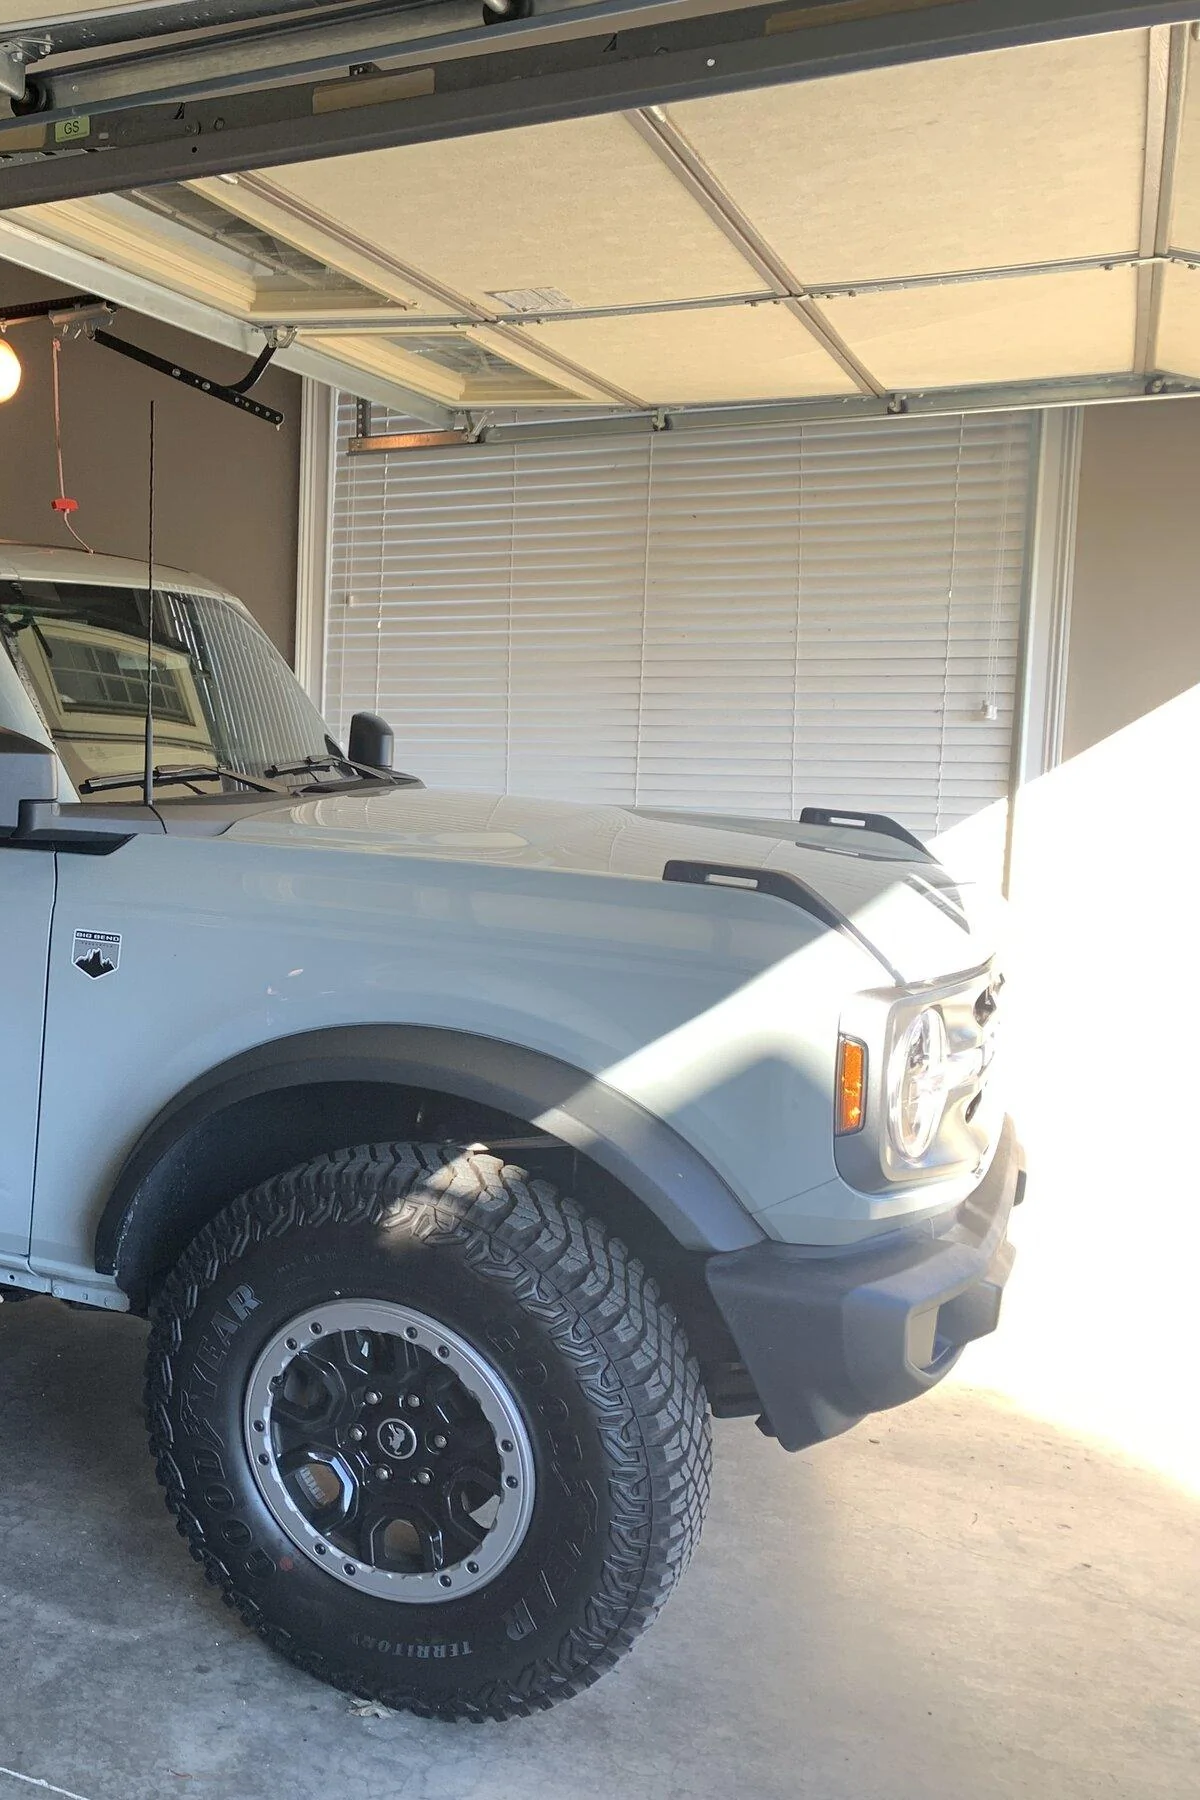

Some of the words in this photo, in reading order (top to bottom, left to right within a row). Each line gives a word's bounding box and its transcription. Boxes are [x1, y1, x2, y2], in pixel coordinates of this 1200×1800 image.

[63, 120, 81, 135] GS
[76, 931, 93, 939] BIG
[93, 934, 120, 942] BEND
